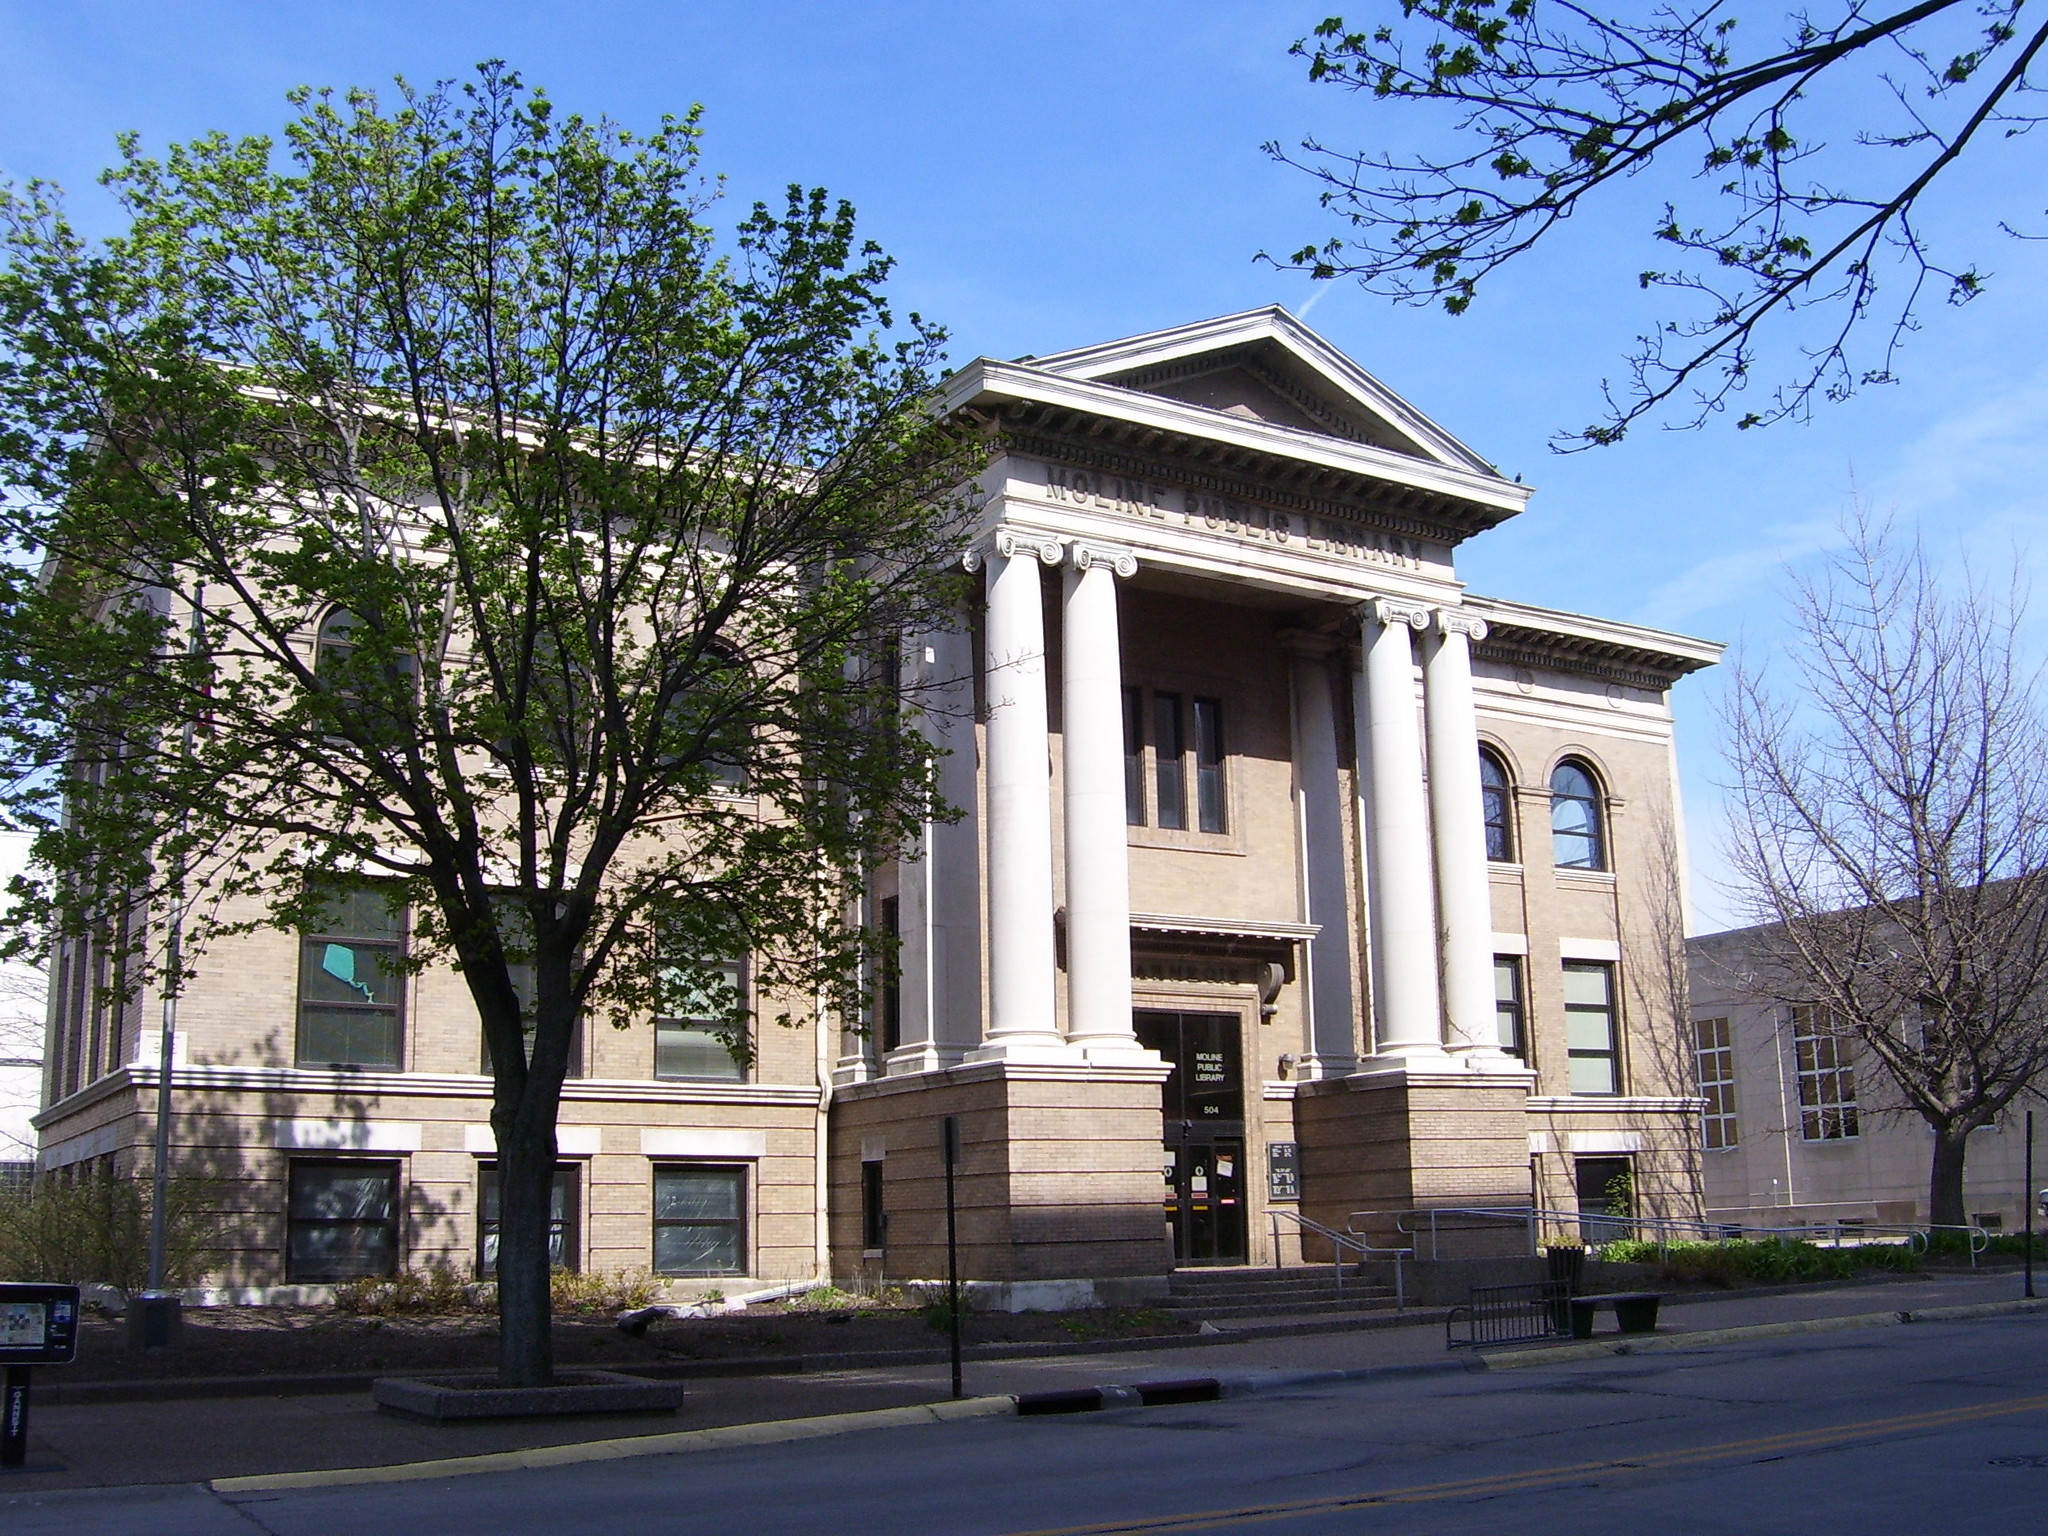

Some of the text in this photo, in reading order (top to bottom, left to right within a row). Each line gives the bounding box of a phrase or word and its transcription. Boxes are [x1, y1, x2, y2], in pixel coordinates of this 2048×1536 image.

[1046, 466, 1423, 570] MOLINE PUBLIC LIBRARY
[1195, 1052, 1224, 1062] MOLINE
[1196, 1063, 1223, 1072] PUBLIC
[1195, 1073, 1226, 1082] LIBRARY
[1203, 1105, 1219, 1114] 504
